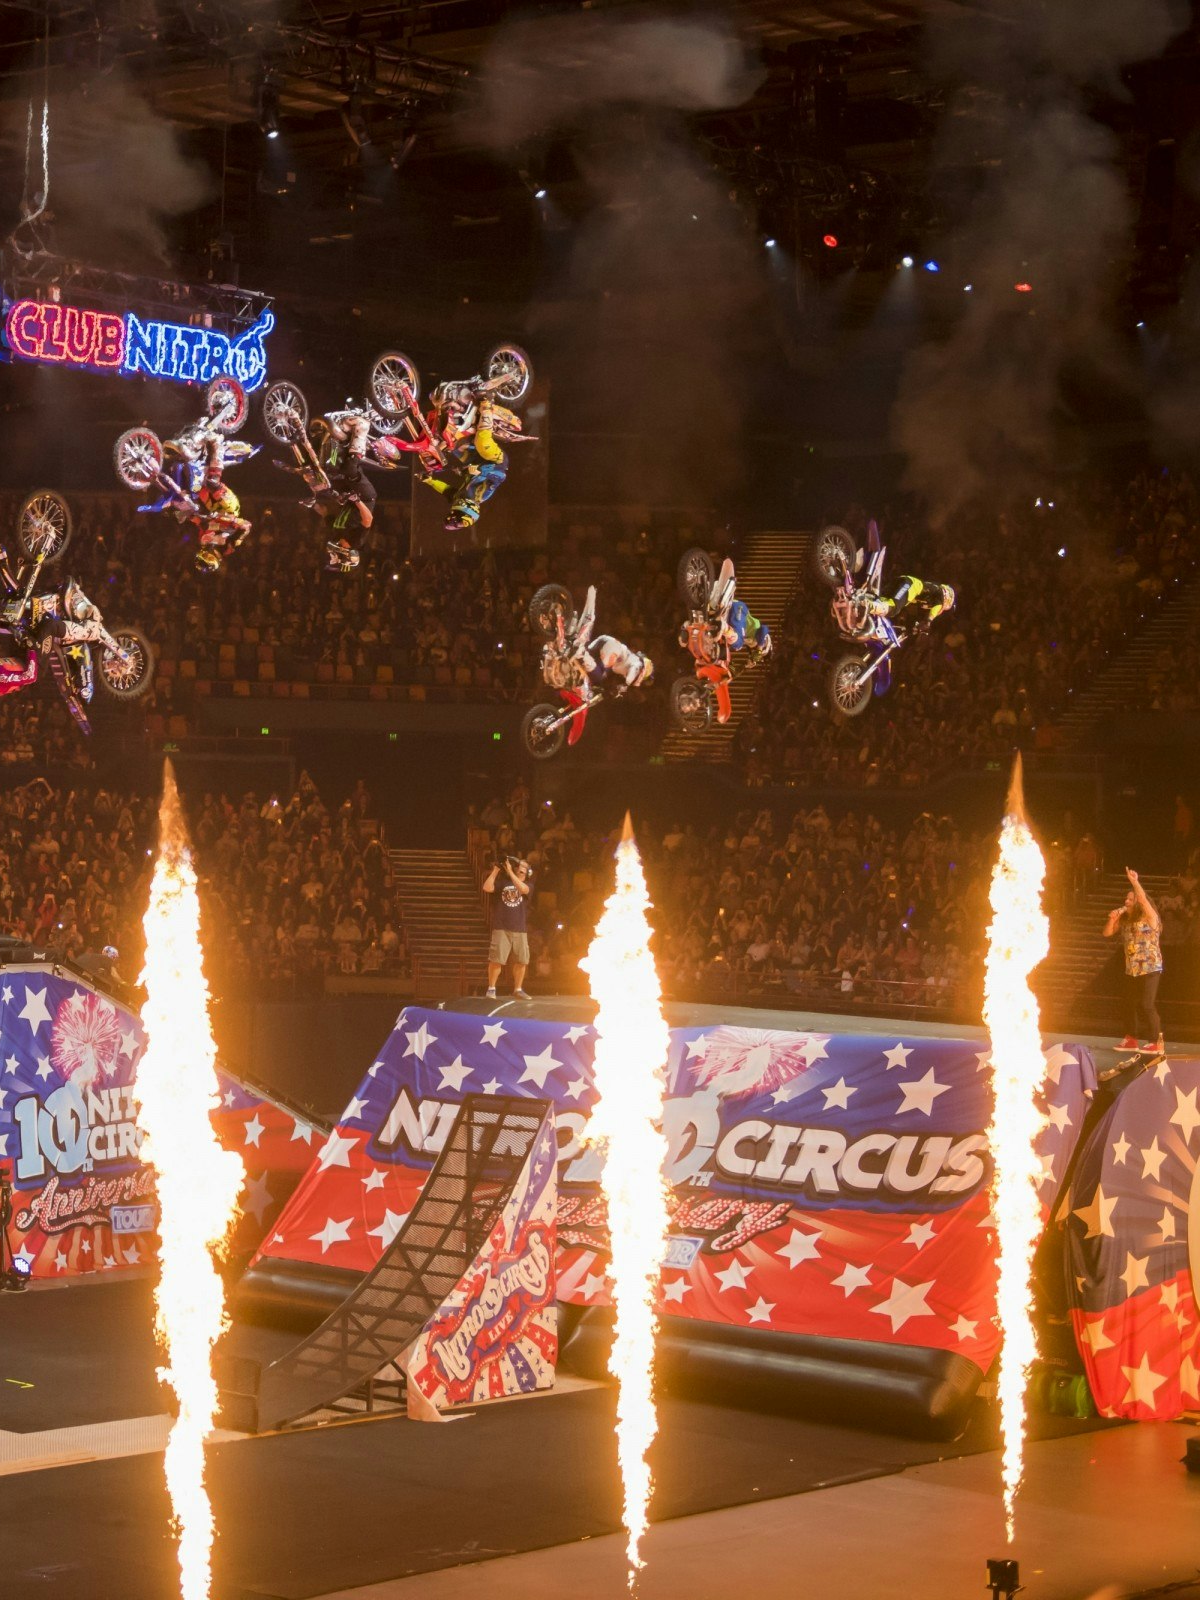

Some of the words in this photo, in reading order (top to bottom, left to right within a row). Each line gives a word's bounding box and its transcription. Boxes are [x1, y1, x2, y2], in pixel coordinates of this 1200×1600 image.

[8, 299, 125, 366] CLUB
[125, 312, 273, 392] NITRO
[87, 1084, 140, 1126] NIT
[88, 1121, 144, 1161] CIR
[715, 1120, 989, 1195] CIRCUS
[432, 1304, 485, 1382] NITRO
[500, 1231, 550, 1297] CIRCUS
[487, 1310, 514, 1341] LIVE
